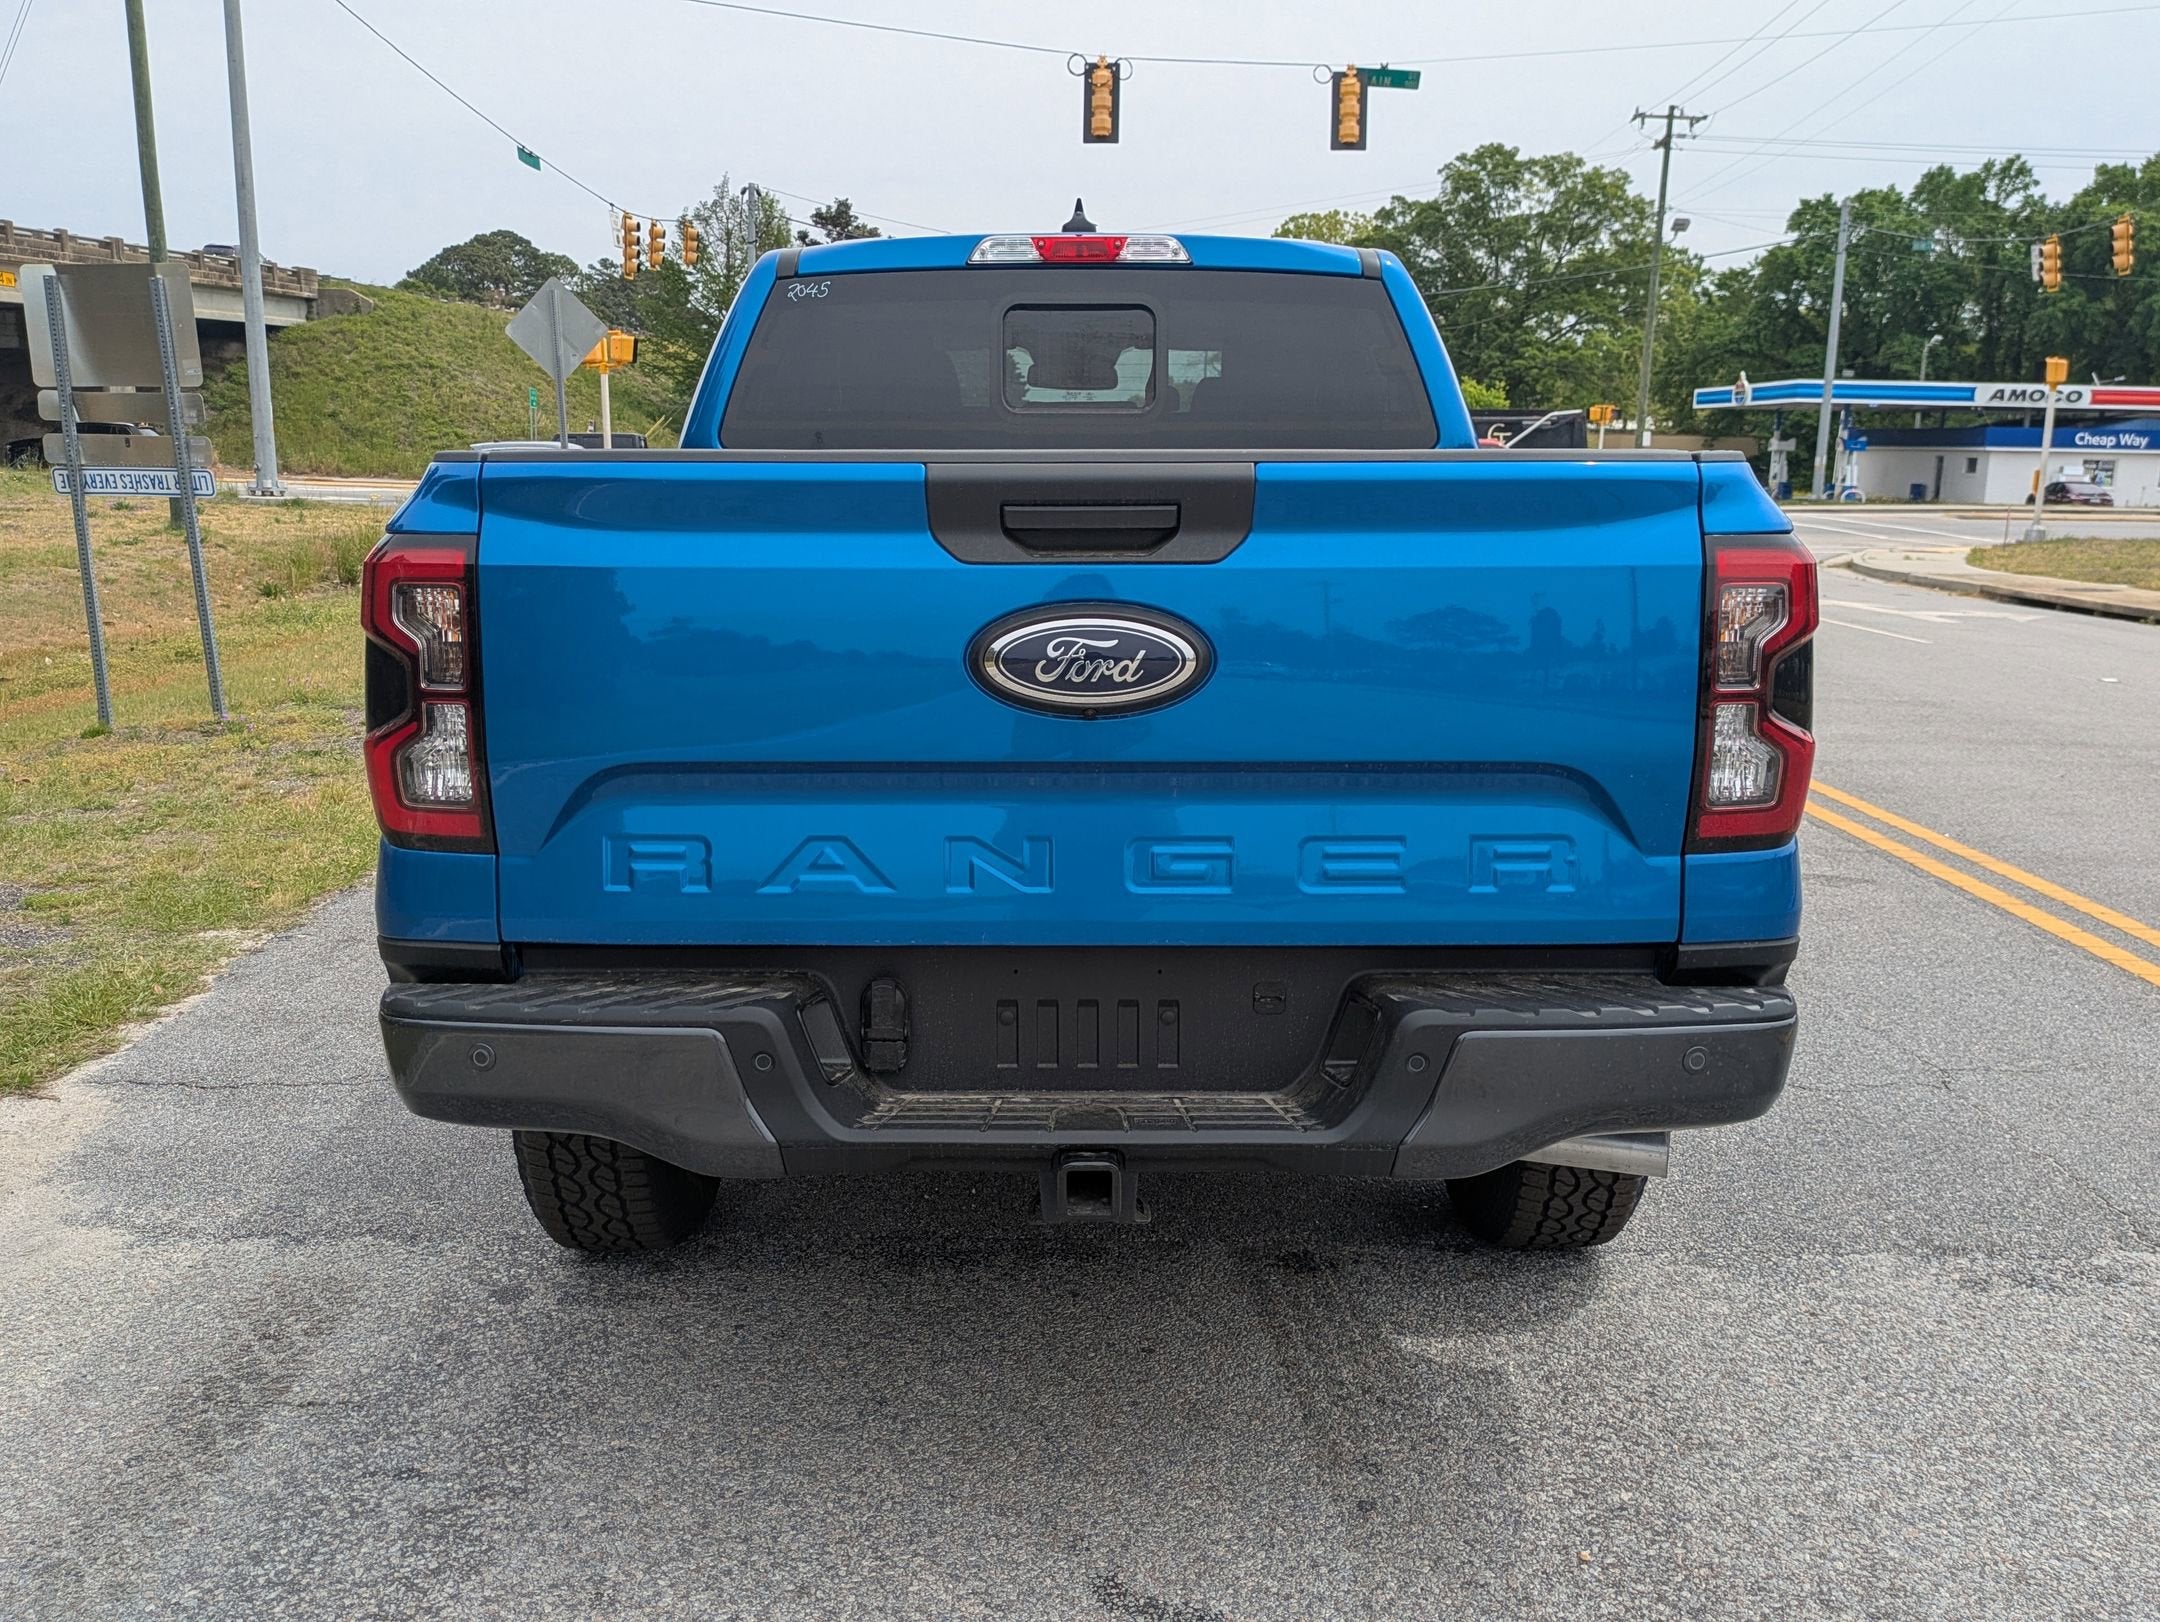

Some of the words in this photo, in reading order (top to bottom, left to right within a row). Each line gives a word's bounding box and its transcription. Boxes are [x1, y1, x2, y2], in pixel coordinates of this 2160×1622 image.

[787, 281, 831, 302] 2045
[2074, 432, 2117, 449] Cheap
[2119, 432, 2150, 449] Way
[120, 473, 172, 490] TRASHES
[173, 473, 210, 491] LITR
[1035, 636, 1147, 683] Ford
[602, 833, 1577, 896] RANGER
